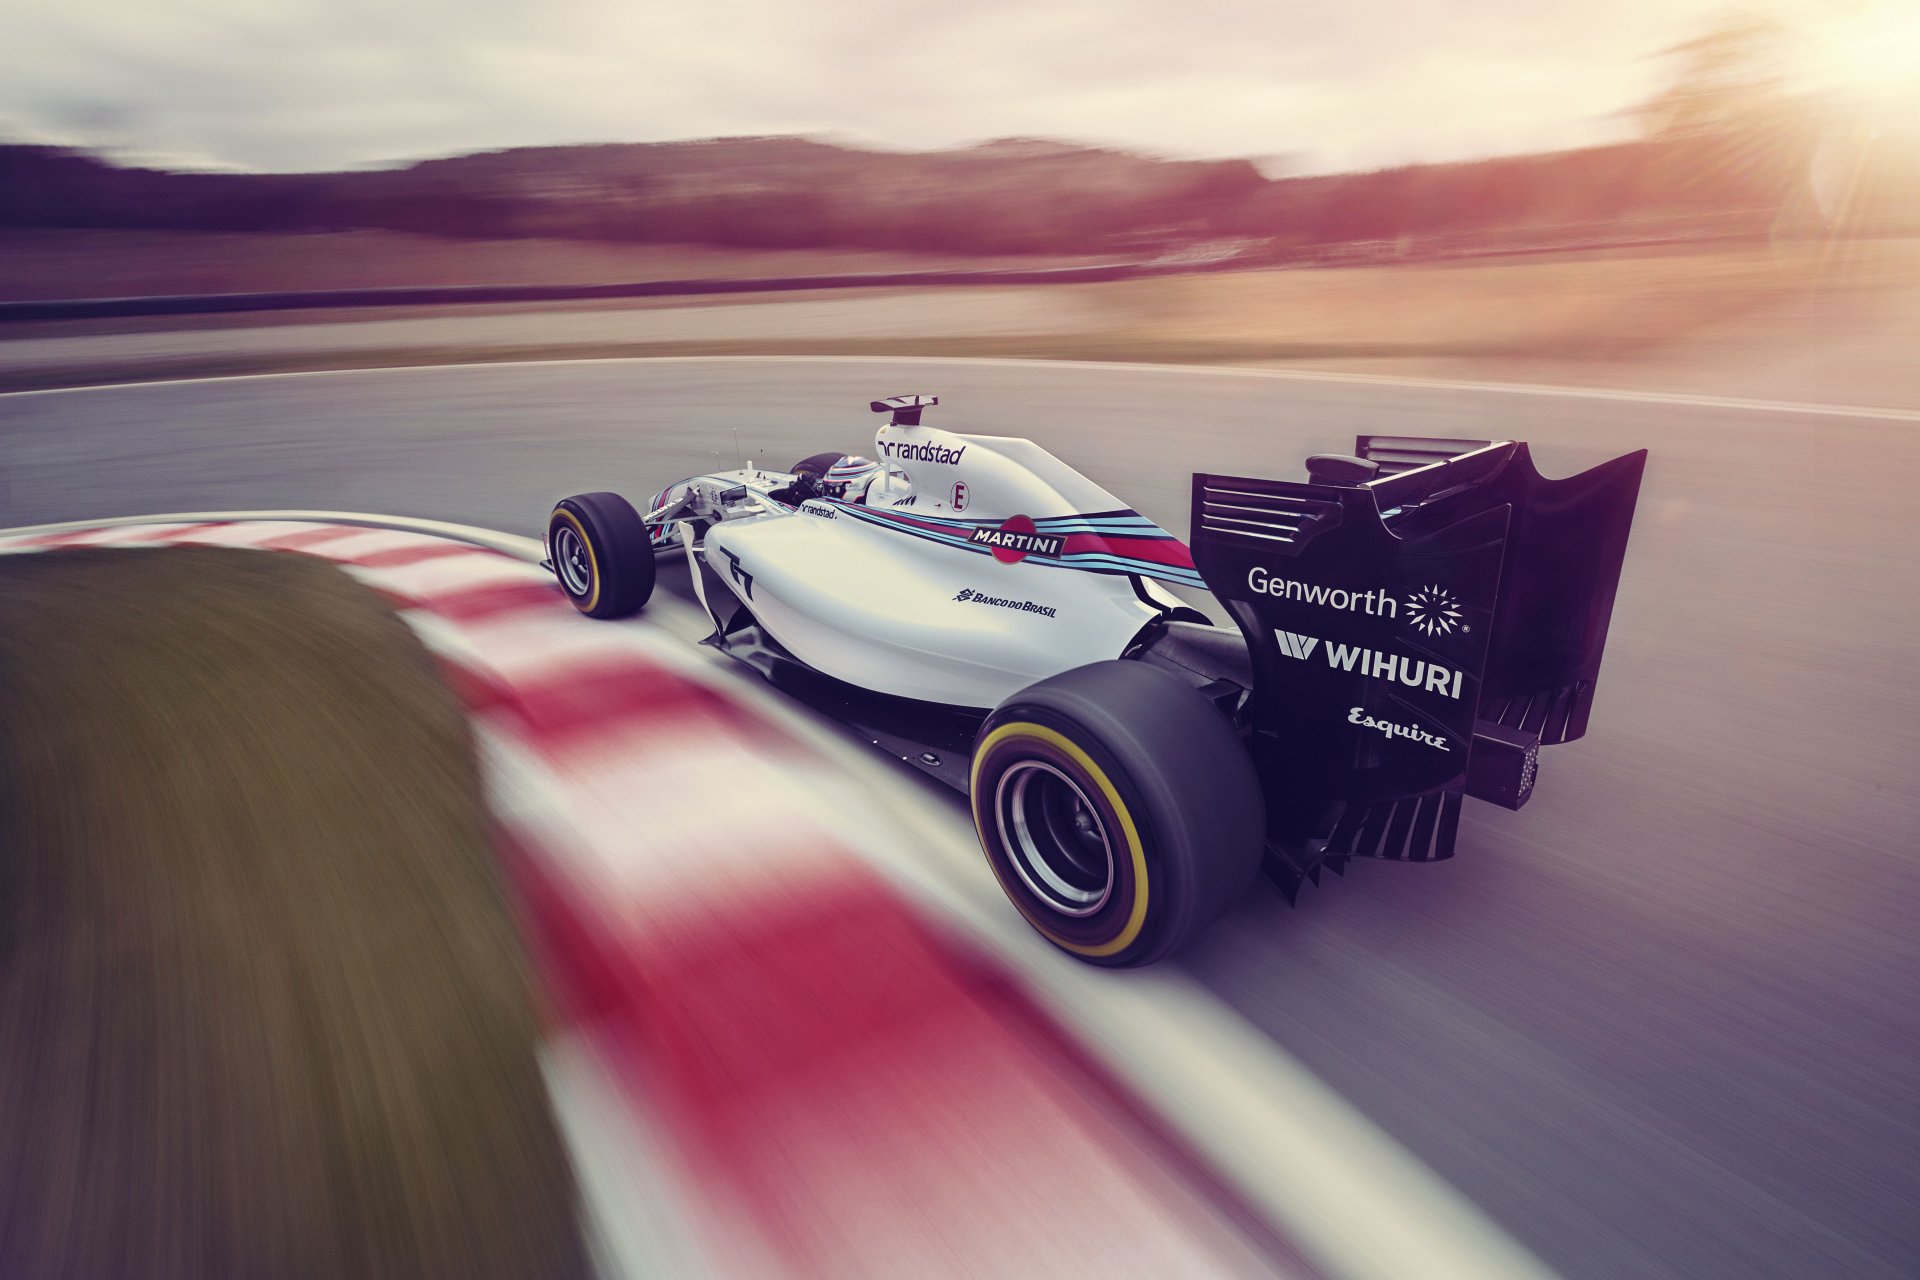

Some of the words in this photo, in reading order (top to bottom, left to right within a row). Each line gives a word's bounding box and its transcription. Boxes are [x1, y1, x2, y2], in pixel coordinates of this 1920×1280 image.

[897, 440, 966, 465] randstad
[954, 484, 964, 509] E
[807, 506, 835, 519] randstad
[974, 529, 1057, 553] MARTINI
[1247, 566, 1397, 618] Genworth
[972, 593, 1008, 607] BANCO
[1008, 601, 1022, 609] DO
[1022, 601, 1056, 618] BRASIL
[1325, 640, 1463, 700] WIHURI
[1347, 707, 1450, 751] Esquire
